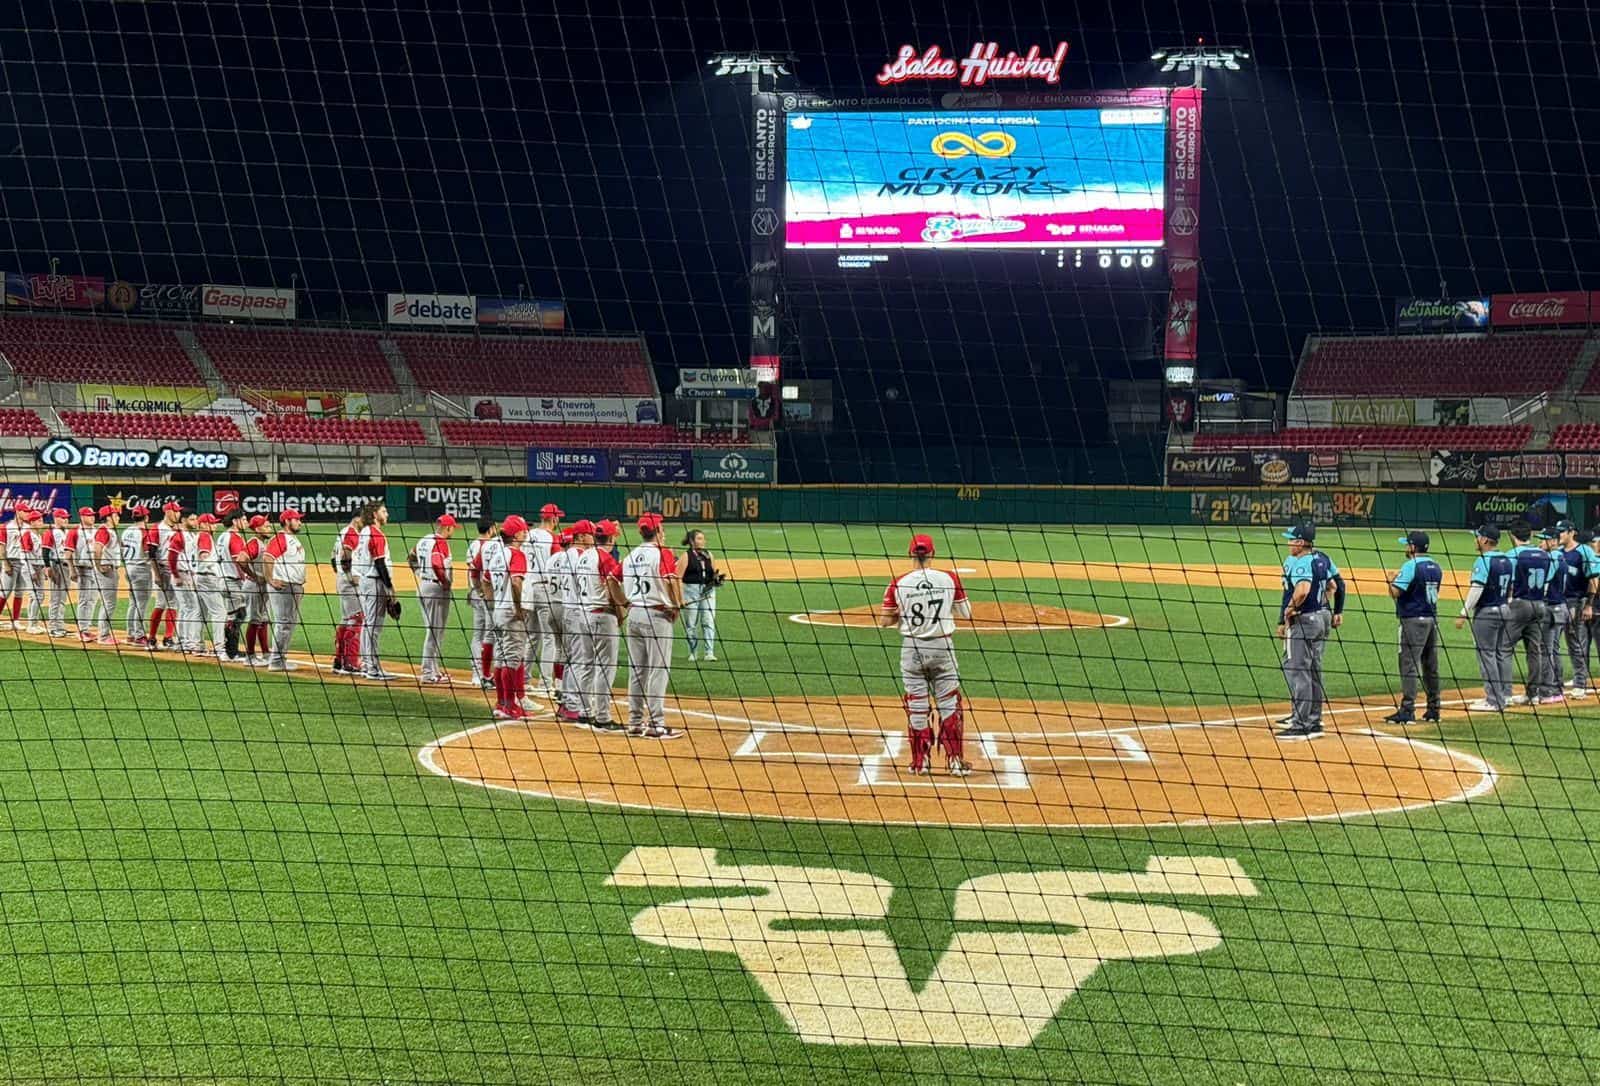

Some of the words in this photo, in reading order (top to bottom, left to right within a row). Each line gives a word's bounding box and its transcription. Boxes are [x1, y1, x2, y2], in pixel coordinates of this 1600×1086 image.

[878, 45, 957, 84] Salsa
[960, 42, 1068, 85] Huichol
[755, 108, 768, 181] ENCANTO
[767, 109, 777, 180] DESARROLLOS
[1175, 106, 1188, 180] ENCANTO
[1187, 107, 1196, 180] DESARROLLOS
[898, 166, 1049, 181] CRAZY
[755, 184, 766, 203] EL
[877, 182, 1072, 198] MOTORS
[1100, 255, 1111, 268] 0
[1120, 255, 1132, 268] 0
[1141, 255, 1153, 268] 0
[204, 290, 288, 312] Gaspasa
[408, 300, 473, 320] debate
[83, 447, 151, 468] Banco
[155, 449, 229, 469] Azteca
[555, 453, 597, 465] HERSA
[703, 470, 732, 479] Banco
[732, 470, 766, 480] Azteca
[414, 487, 482, 503] POWER
[445, 503, 482, 519] ADE
[1211, 499, 1230, 522] 21
[911, 598, 944, 628] 87
